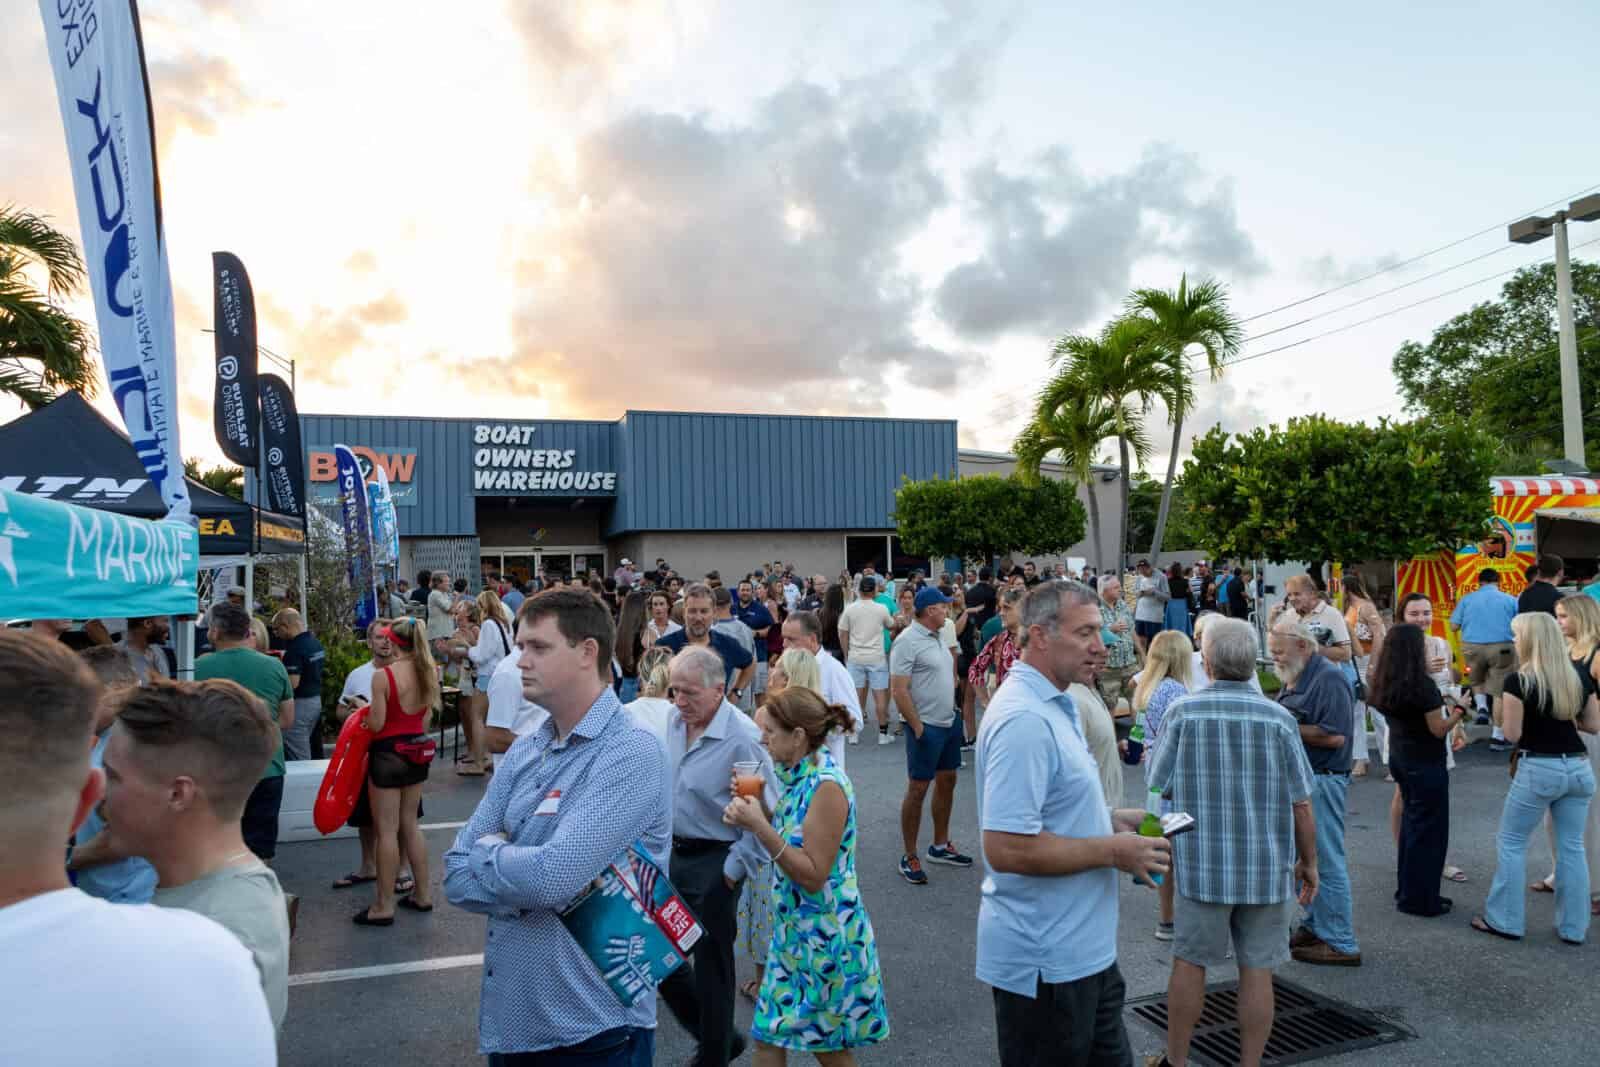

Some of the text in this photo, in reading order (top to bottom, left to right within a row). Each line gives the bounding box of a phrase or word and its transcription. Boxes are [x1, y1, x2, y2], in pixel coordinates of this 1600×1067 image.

[133, 288, 155, 362] MARINE
[146, 369, 168, 474] TIMATE
[474, 425, 536, 445] BOAT
[309, 446, 417, 488] BOW
[474, 449, 576, 469] OWNERS
[474, 471, 617, 491] WAREHOUSE
[66, 510, 193, 585] MARINE
